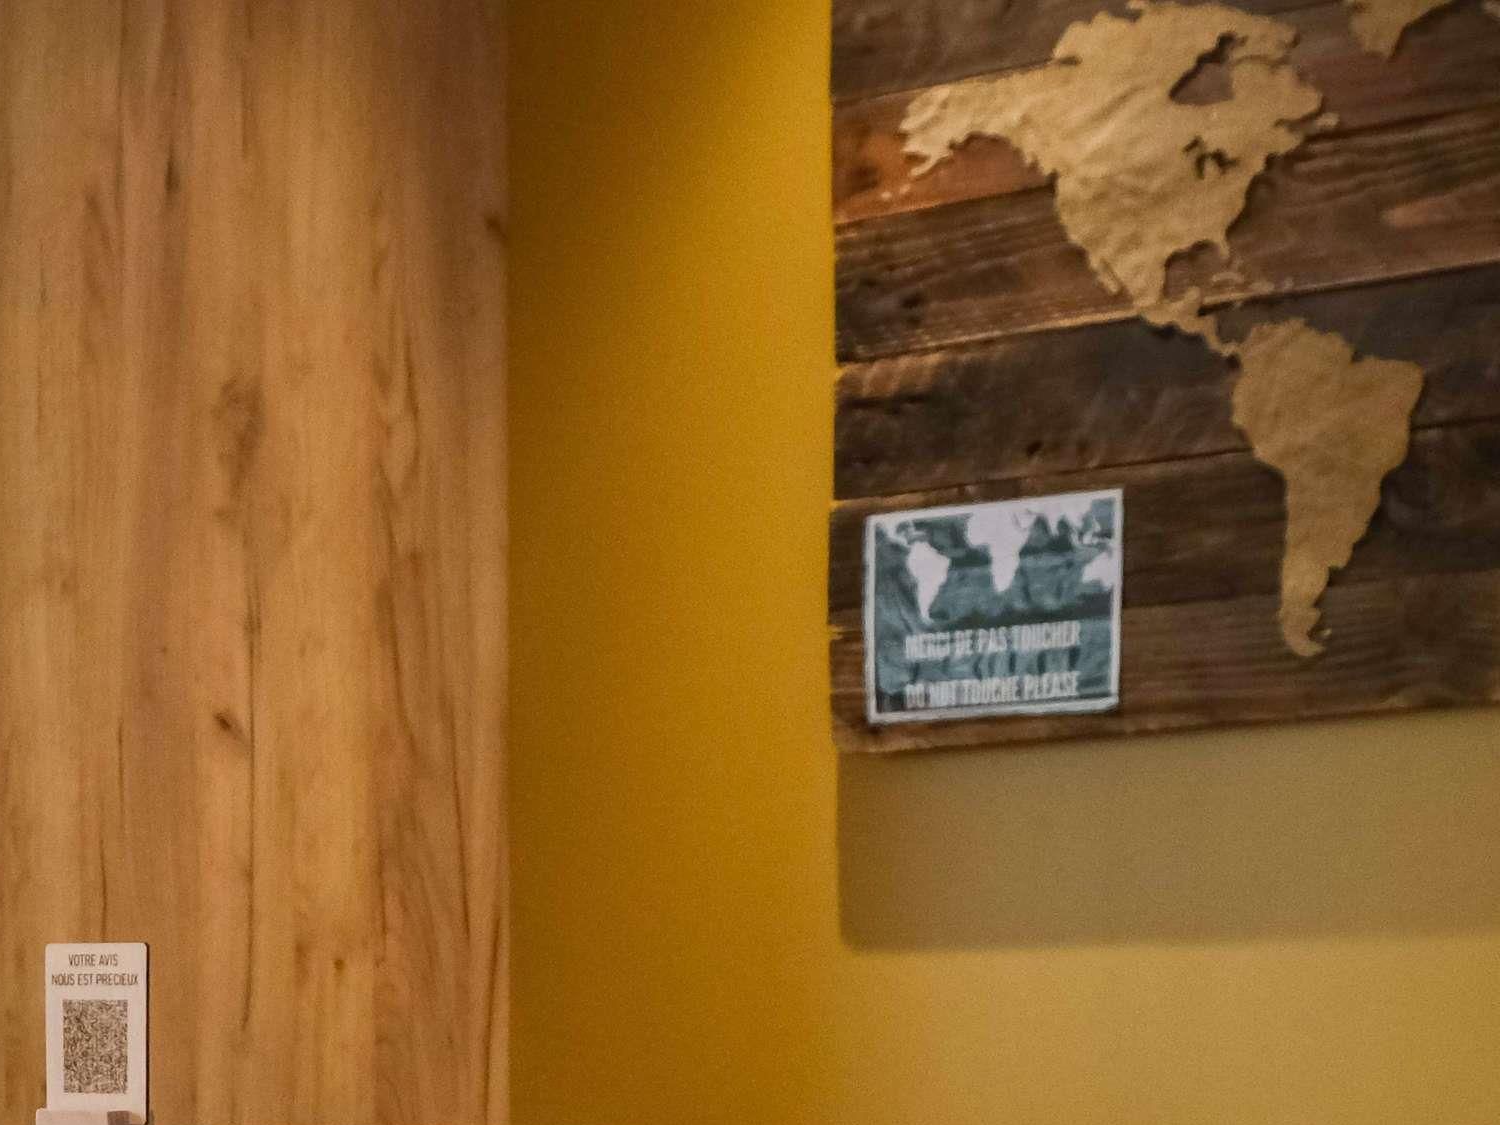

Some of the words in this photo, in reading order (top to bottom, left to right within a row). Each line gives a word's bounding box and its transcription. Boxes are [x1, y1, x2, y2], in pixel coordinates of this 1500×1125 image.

[978, 626, 1007, 653] PAS
[1011, 620, 1081, 651] TOUCHER
[1023, 670, 1081, 701] PLEASE
[68, 953, 95, 967] VOTRE
[98, 953, 119, 967] AVIS
[51, 973, 75, 986] NOUS
[77, 973, 93, 986] EST
